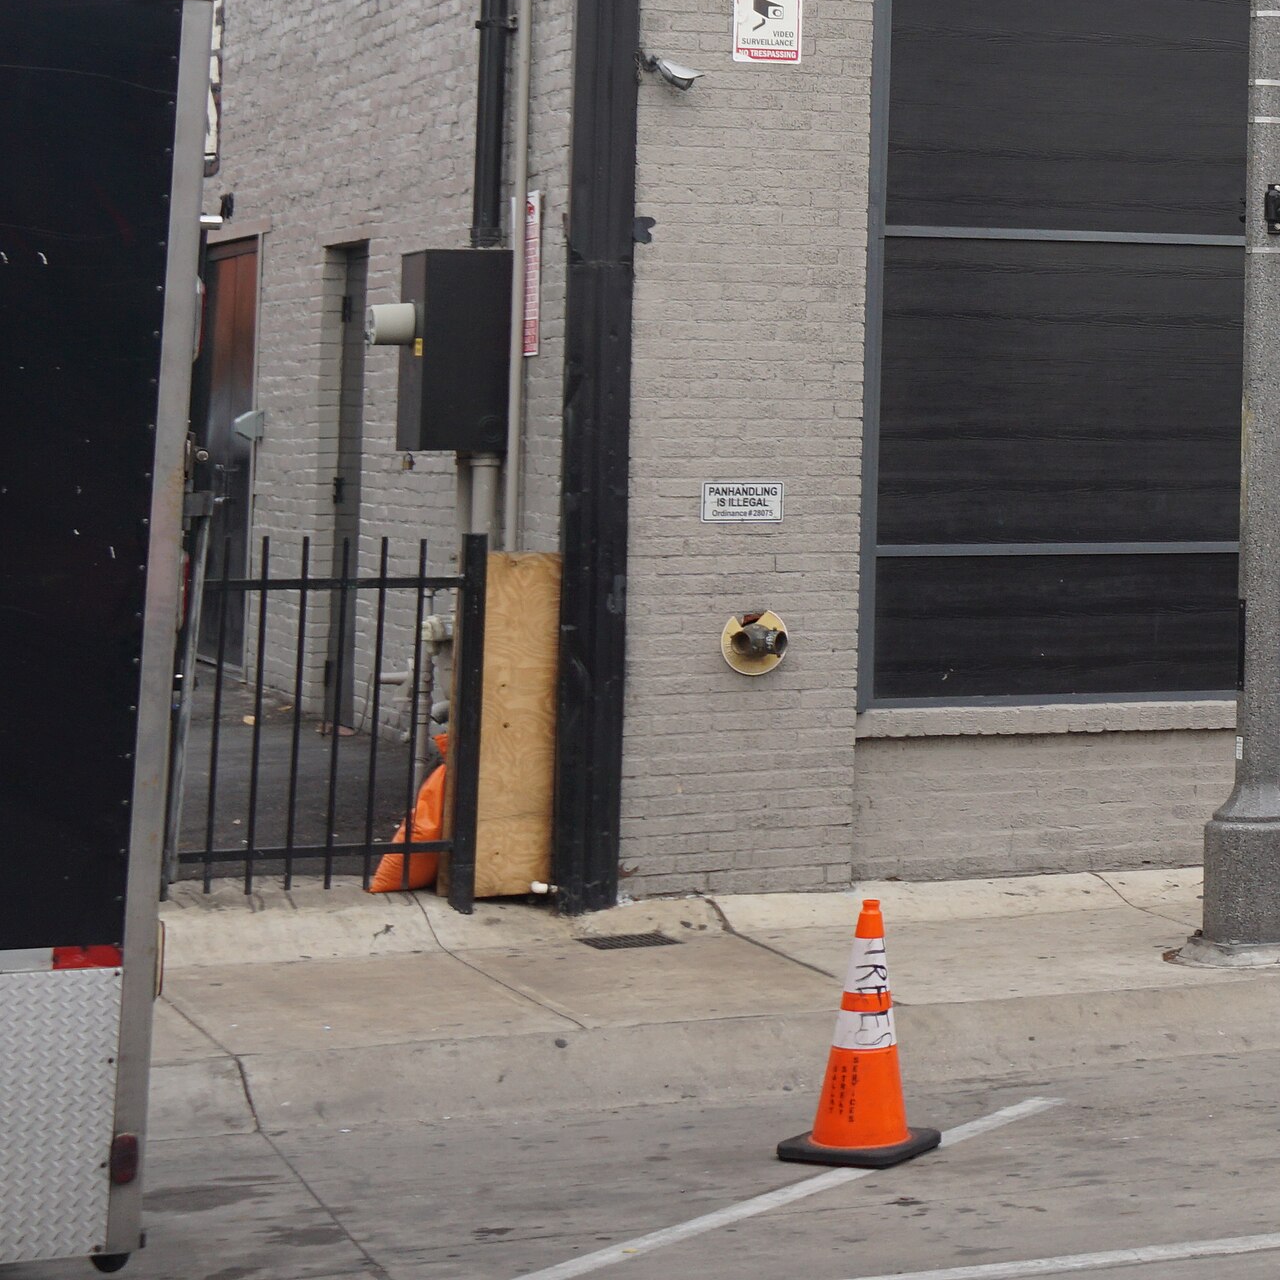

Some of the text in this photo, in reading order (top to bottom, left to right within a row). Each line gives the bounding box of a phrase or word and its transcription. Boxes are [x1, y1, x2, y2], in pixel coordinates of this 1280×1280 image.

[772, 30, 794, 38] VIDEO
[741, 37, 794, 47] SURVEILLANCE
[738, 49, 797, 59] NO TRESPASSING
[708, 486, 778, 496] PANHANDLING
[716, 497, 769, 507] IS ILLEGAL
[711, 509, 747, 517] Ordinance
